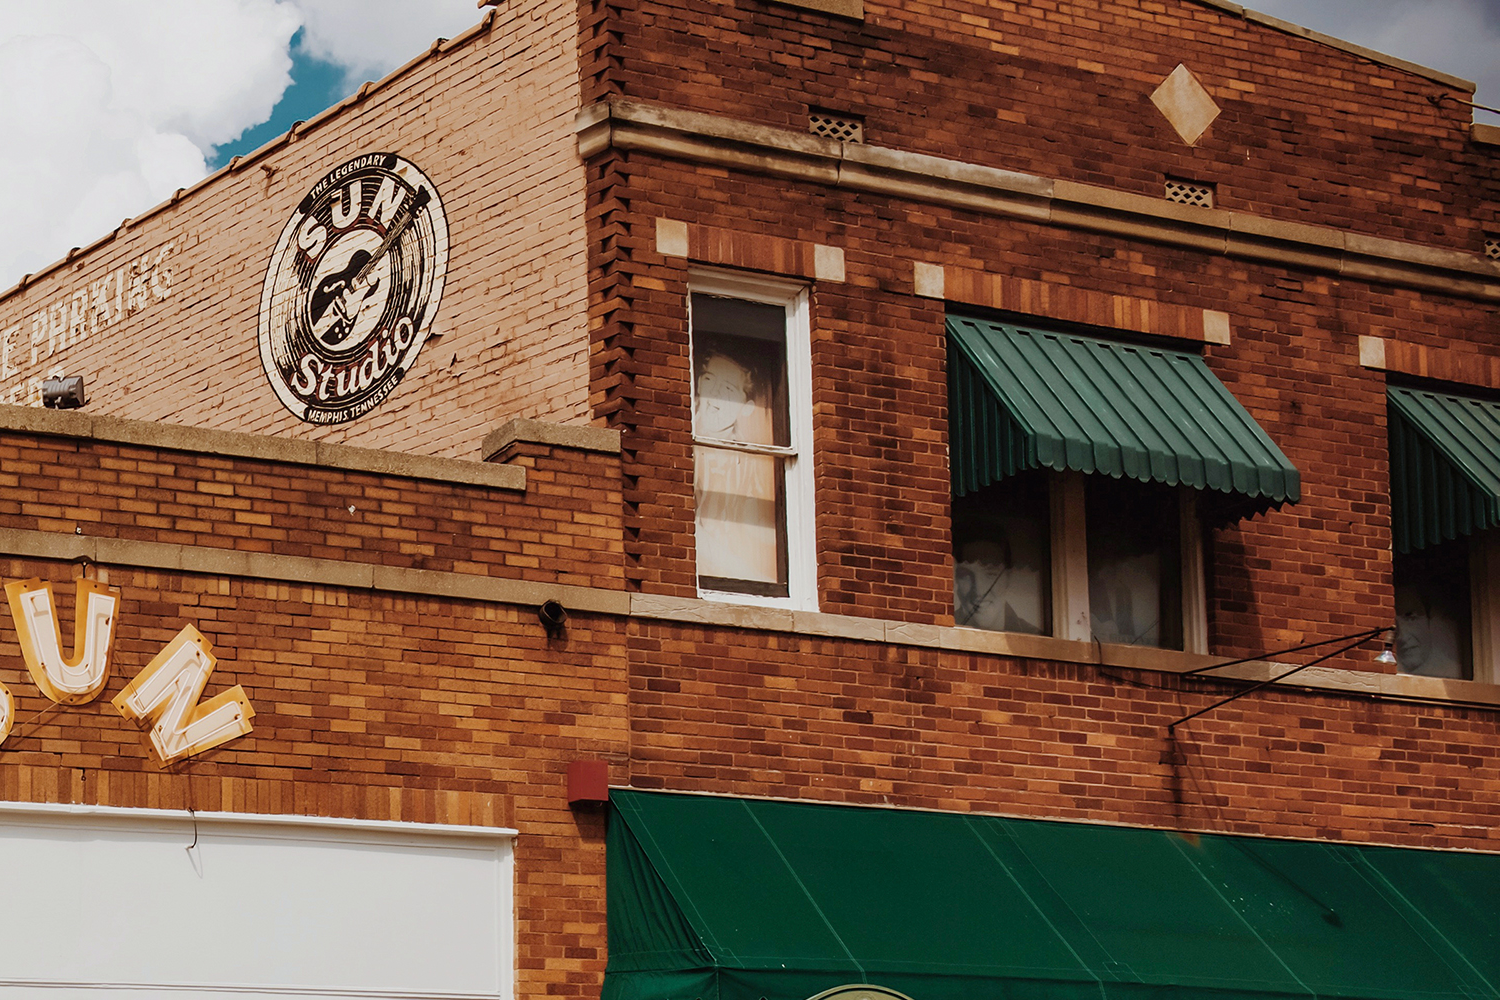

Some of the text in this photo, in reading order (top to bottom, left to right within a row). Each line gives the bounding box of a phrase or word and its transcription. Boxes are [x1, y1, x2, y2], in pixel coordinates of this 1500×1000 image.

[310, 154, 387, 200] THE LEGENDARY
[298, 176, 407, 259] SUN
[30, 242, 175, 366] PARKING
[349, 376, 399, 418] TENNESSEE
